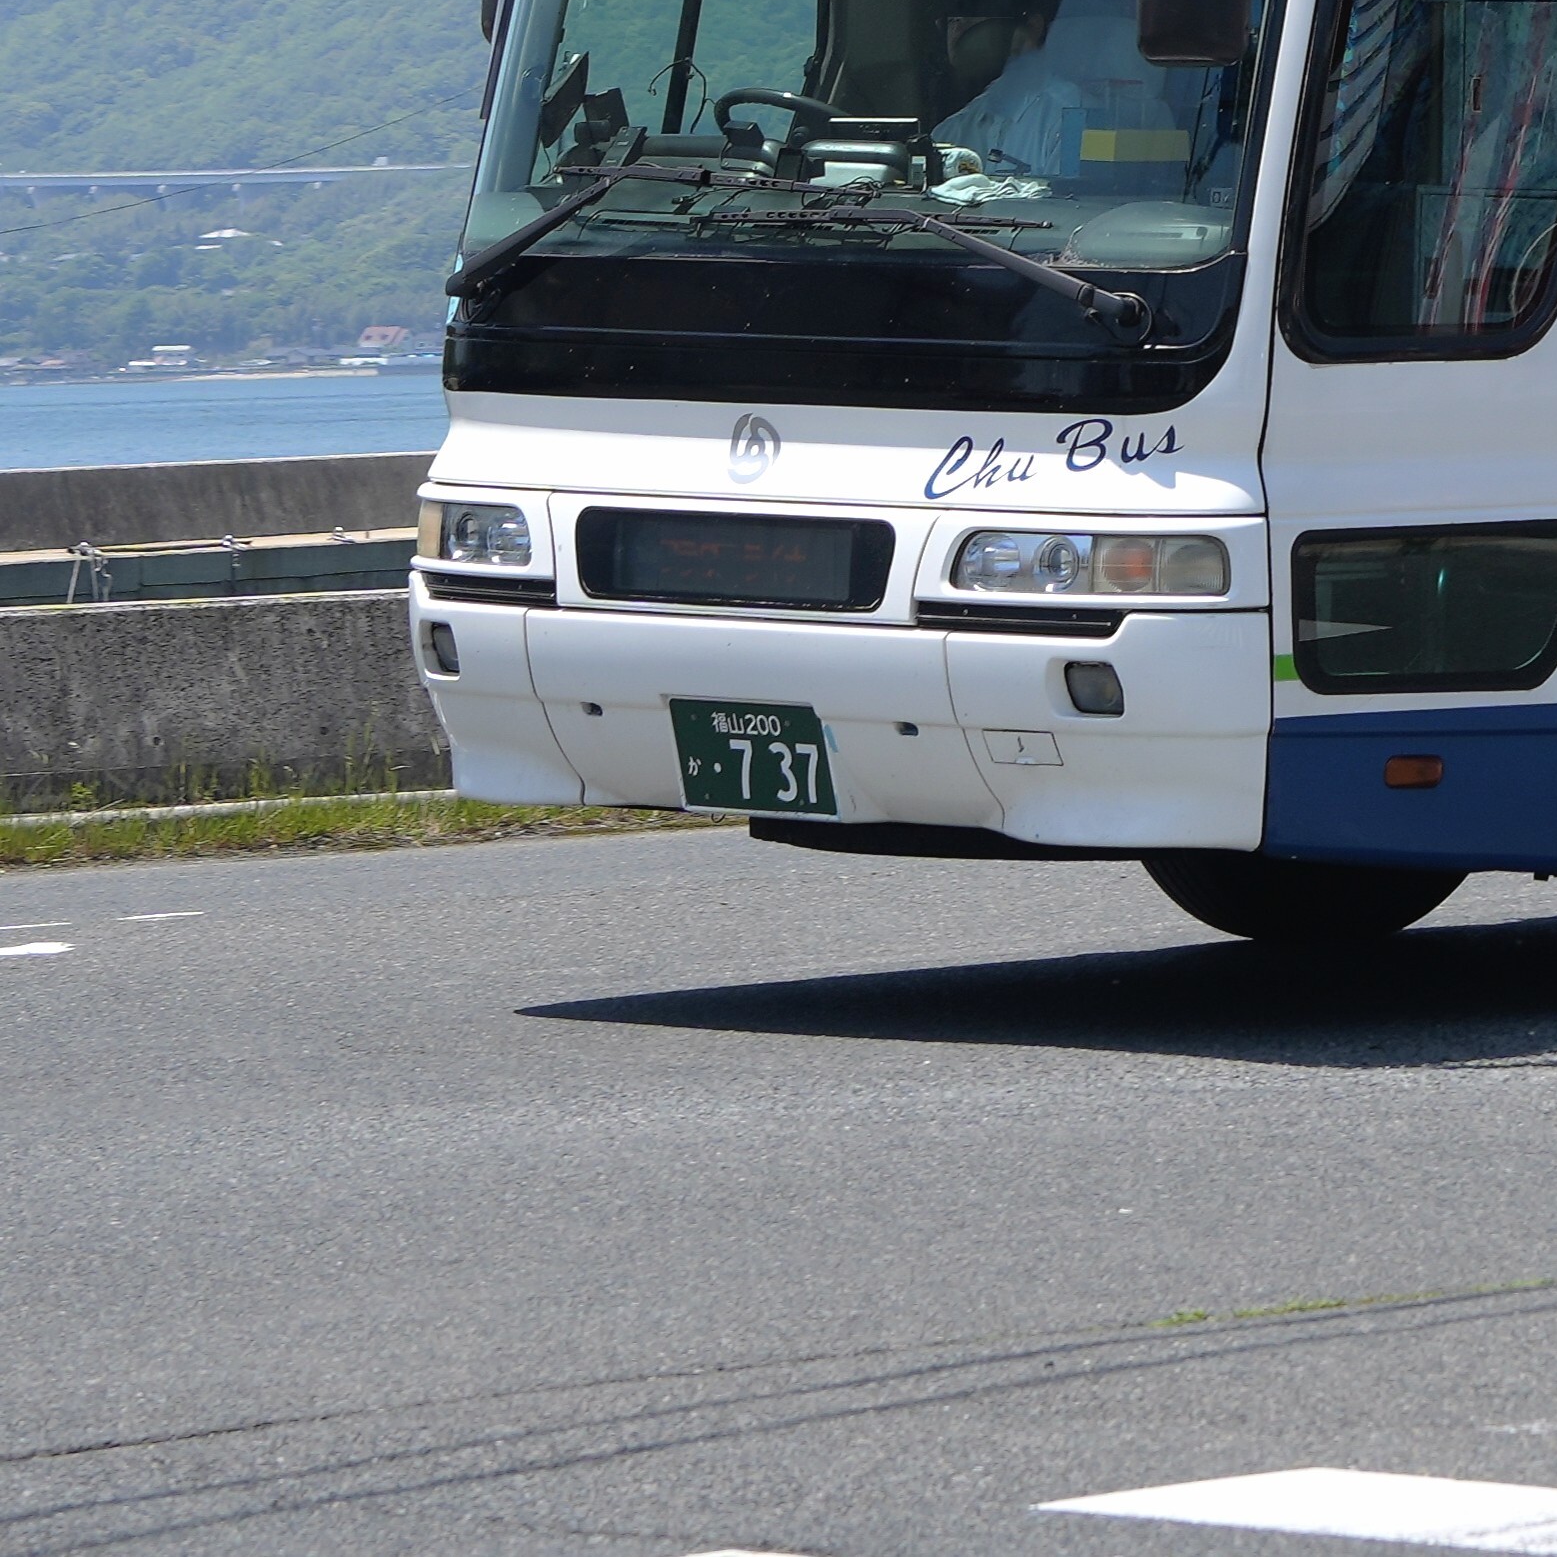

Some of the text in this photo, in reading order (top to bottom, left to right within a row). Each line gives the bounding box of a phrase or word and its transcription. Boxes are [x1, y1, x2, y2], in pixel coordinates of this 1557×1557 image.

[924, 418, 1185, 500] Chu Bus
[711, 711, 782, 737] 福山200
